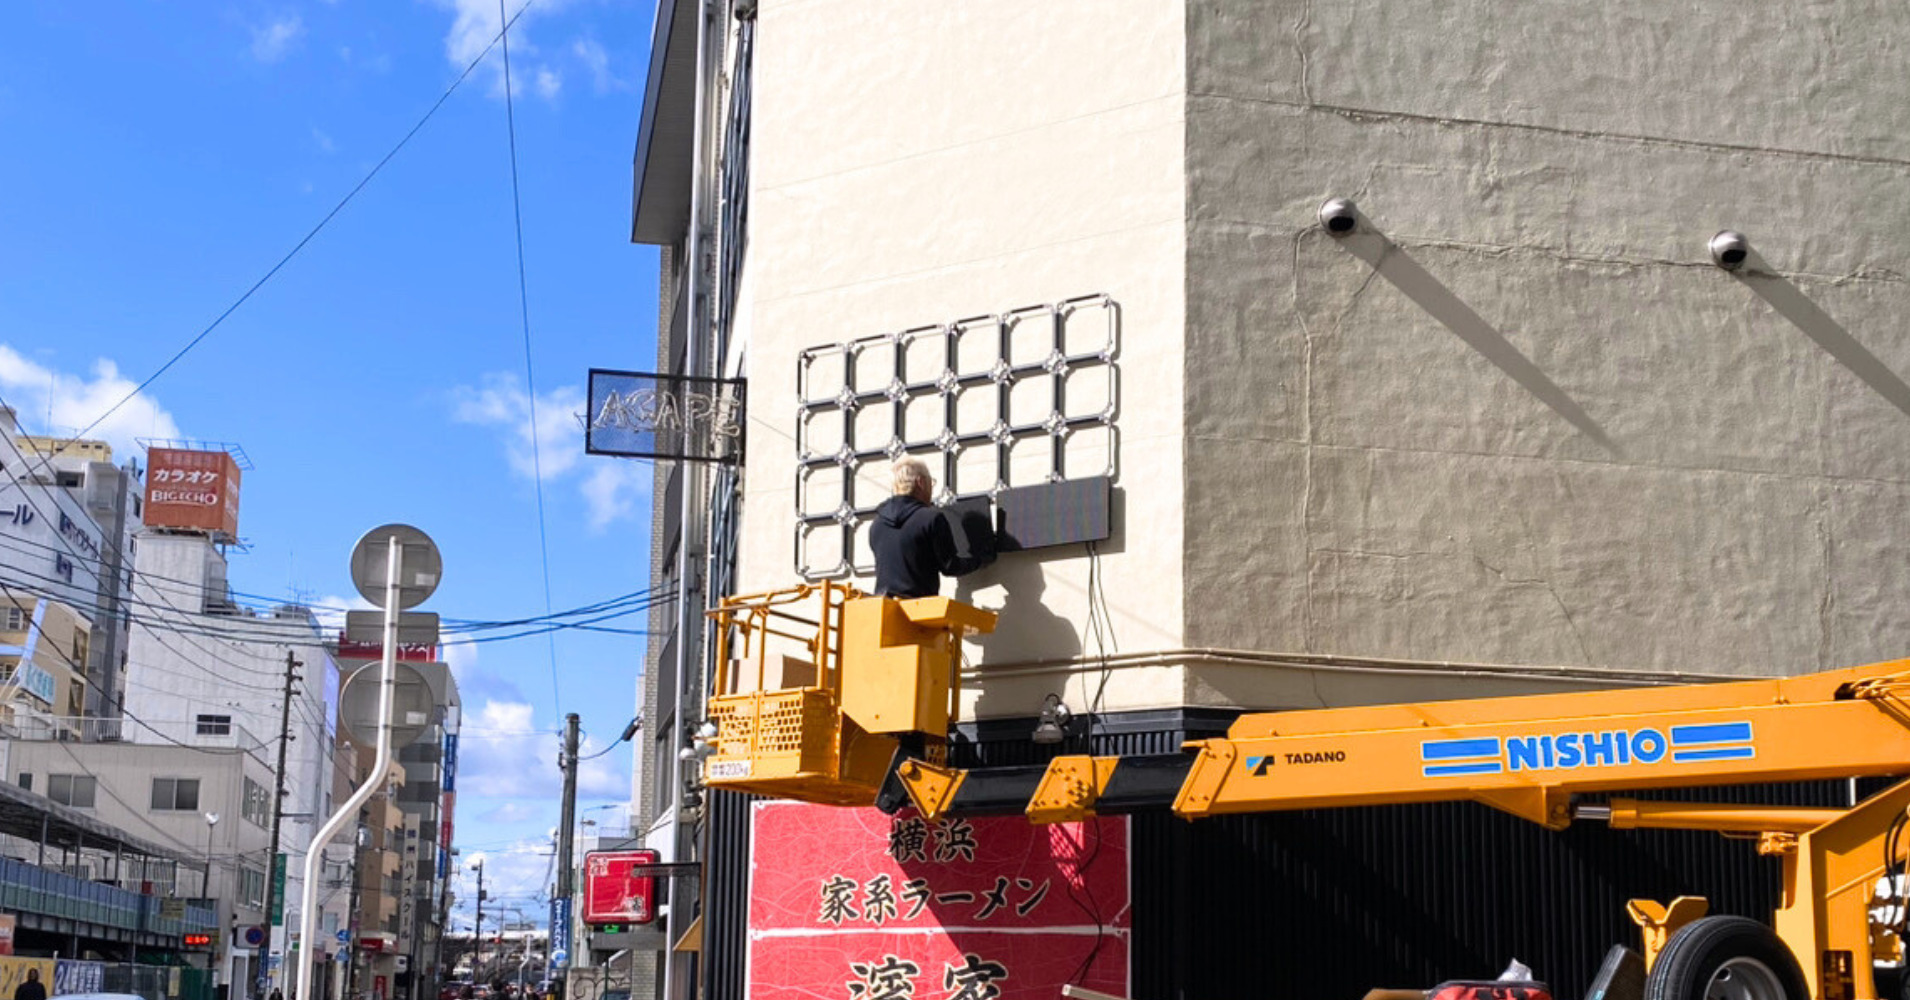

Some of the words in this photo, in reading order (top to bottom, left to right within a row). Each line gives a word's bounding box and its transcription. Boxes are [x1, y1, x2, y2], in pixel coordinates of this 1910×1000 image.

[153, 468, 219, 484] カラオケ
[1284, 750, 1346, 766] TADANO
[1506, 729, 1666, 771] NISHIO
[889, 818, 978, 863] 横浜
[818, 875, 1051, 924] 家系ラーメン
